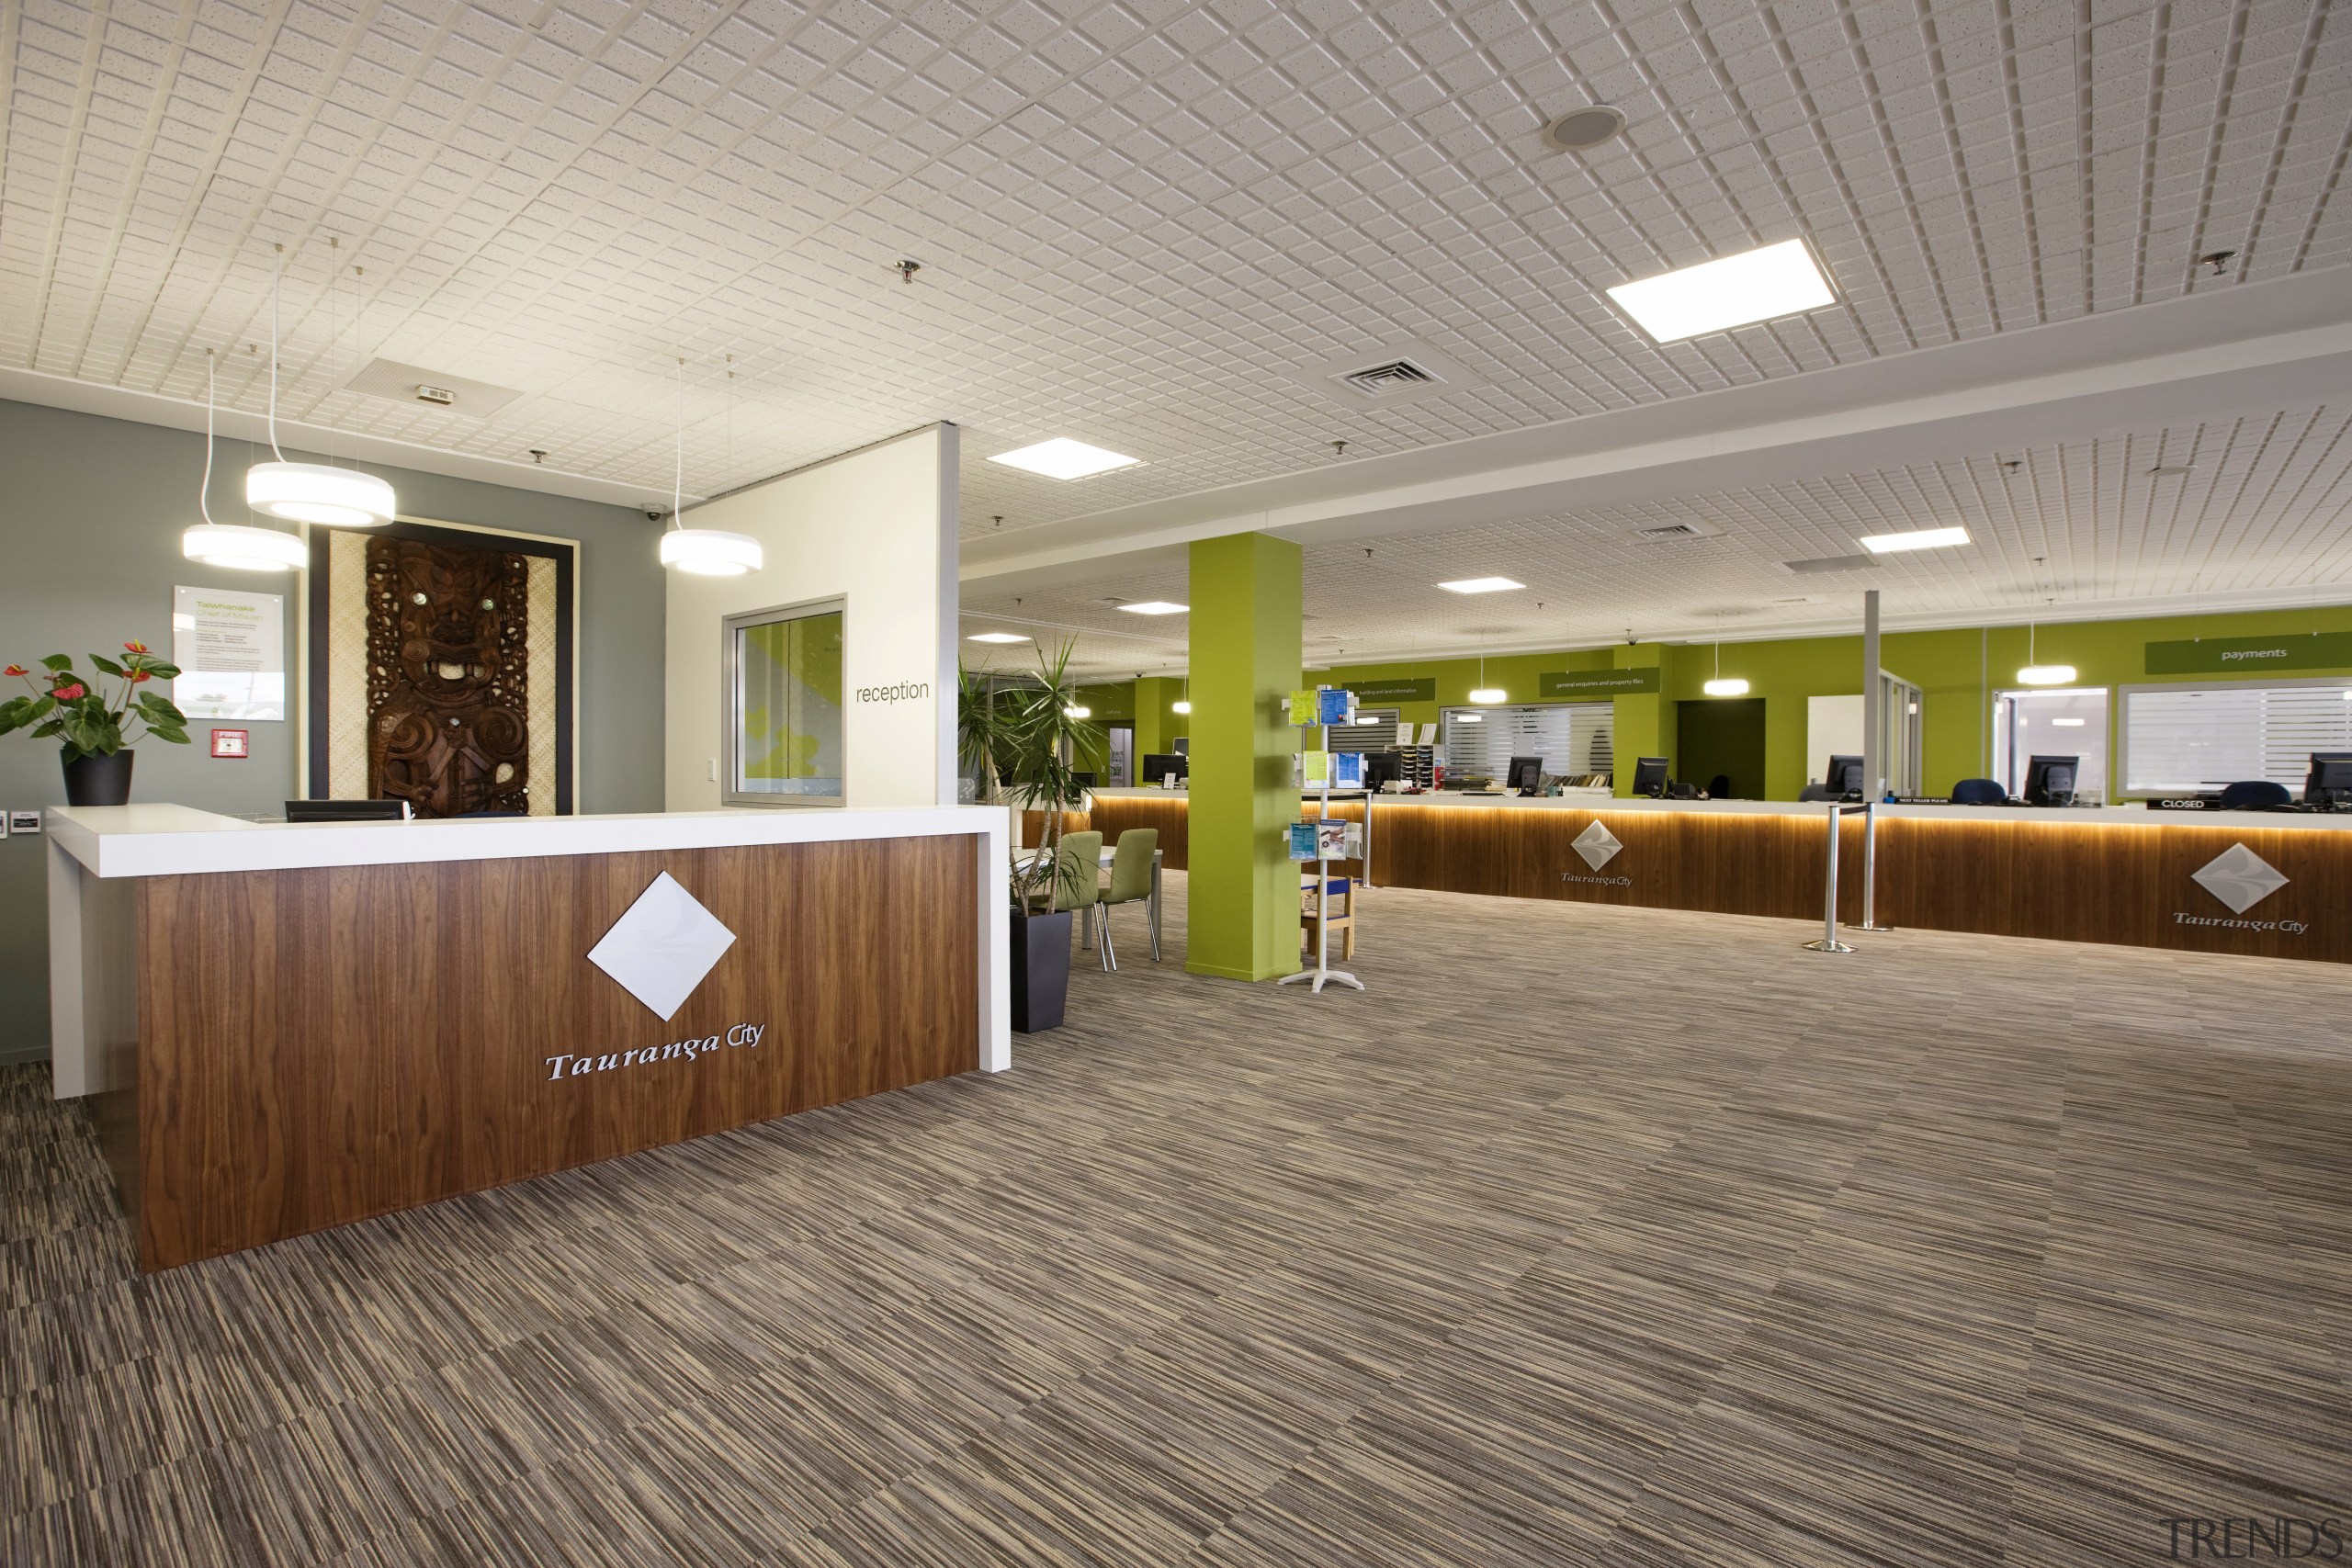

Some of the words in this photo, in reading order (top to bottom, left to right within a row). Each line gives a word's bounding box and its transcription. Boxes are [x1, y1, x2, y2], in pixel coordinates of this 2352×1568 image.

[2222, 649, 2288, 660] payments
[1575, 681, 1599, 689] enquiries
[1610, 679, 1633, 687] property
[856, 680, 929, 705] reception
[2161, 799, 2205, 808] CLOSED
[1561, 872, 1616, 886] Tauranga
[1616, 876, 1633, 887] City
[2173, 912, 2277, 932] Tauranga
[2278, 919, 2309, 935] City
[545, 1034, 720, 1081] Tauranga
[726, 1022, 765, 1048] City
